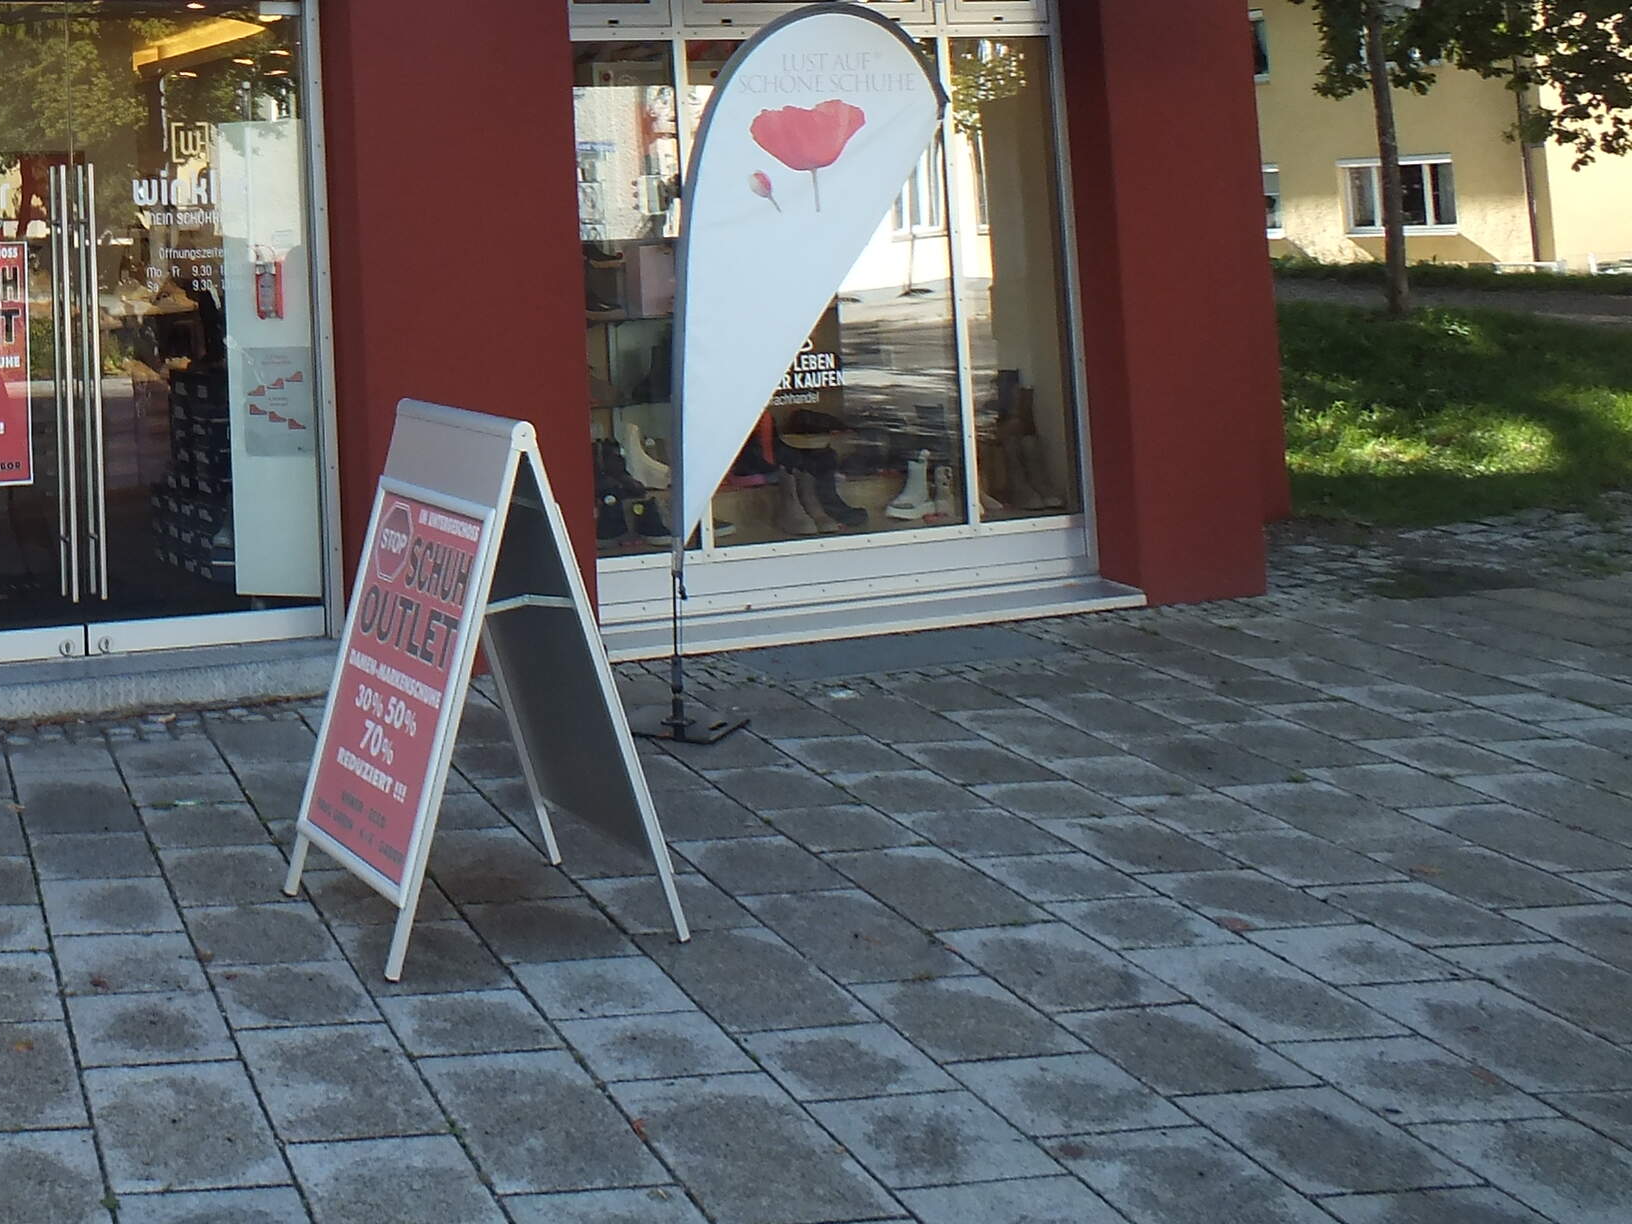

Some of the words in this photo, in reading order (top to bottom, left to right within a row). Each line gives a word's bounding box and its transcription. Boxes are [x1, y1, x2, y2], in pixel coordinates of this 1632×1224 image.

[781, 53, 828, 72] LUST
[829, 73, 916, 93] SCHUHE
[793, 353, 835, 371] LEBEN
[793, 370, 845, 389] KAUFEN
[380, 527, 408, 555] STOP
[404, 535, 474, 609] SCHUH
[359, 583, 460, 673] OUTLET
[354, 683, 384, 719] 30%
[384, 695, 417, 738] 50%
[359, 719, 394, 766] 70%
